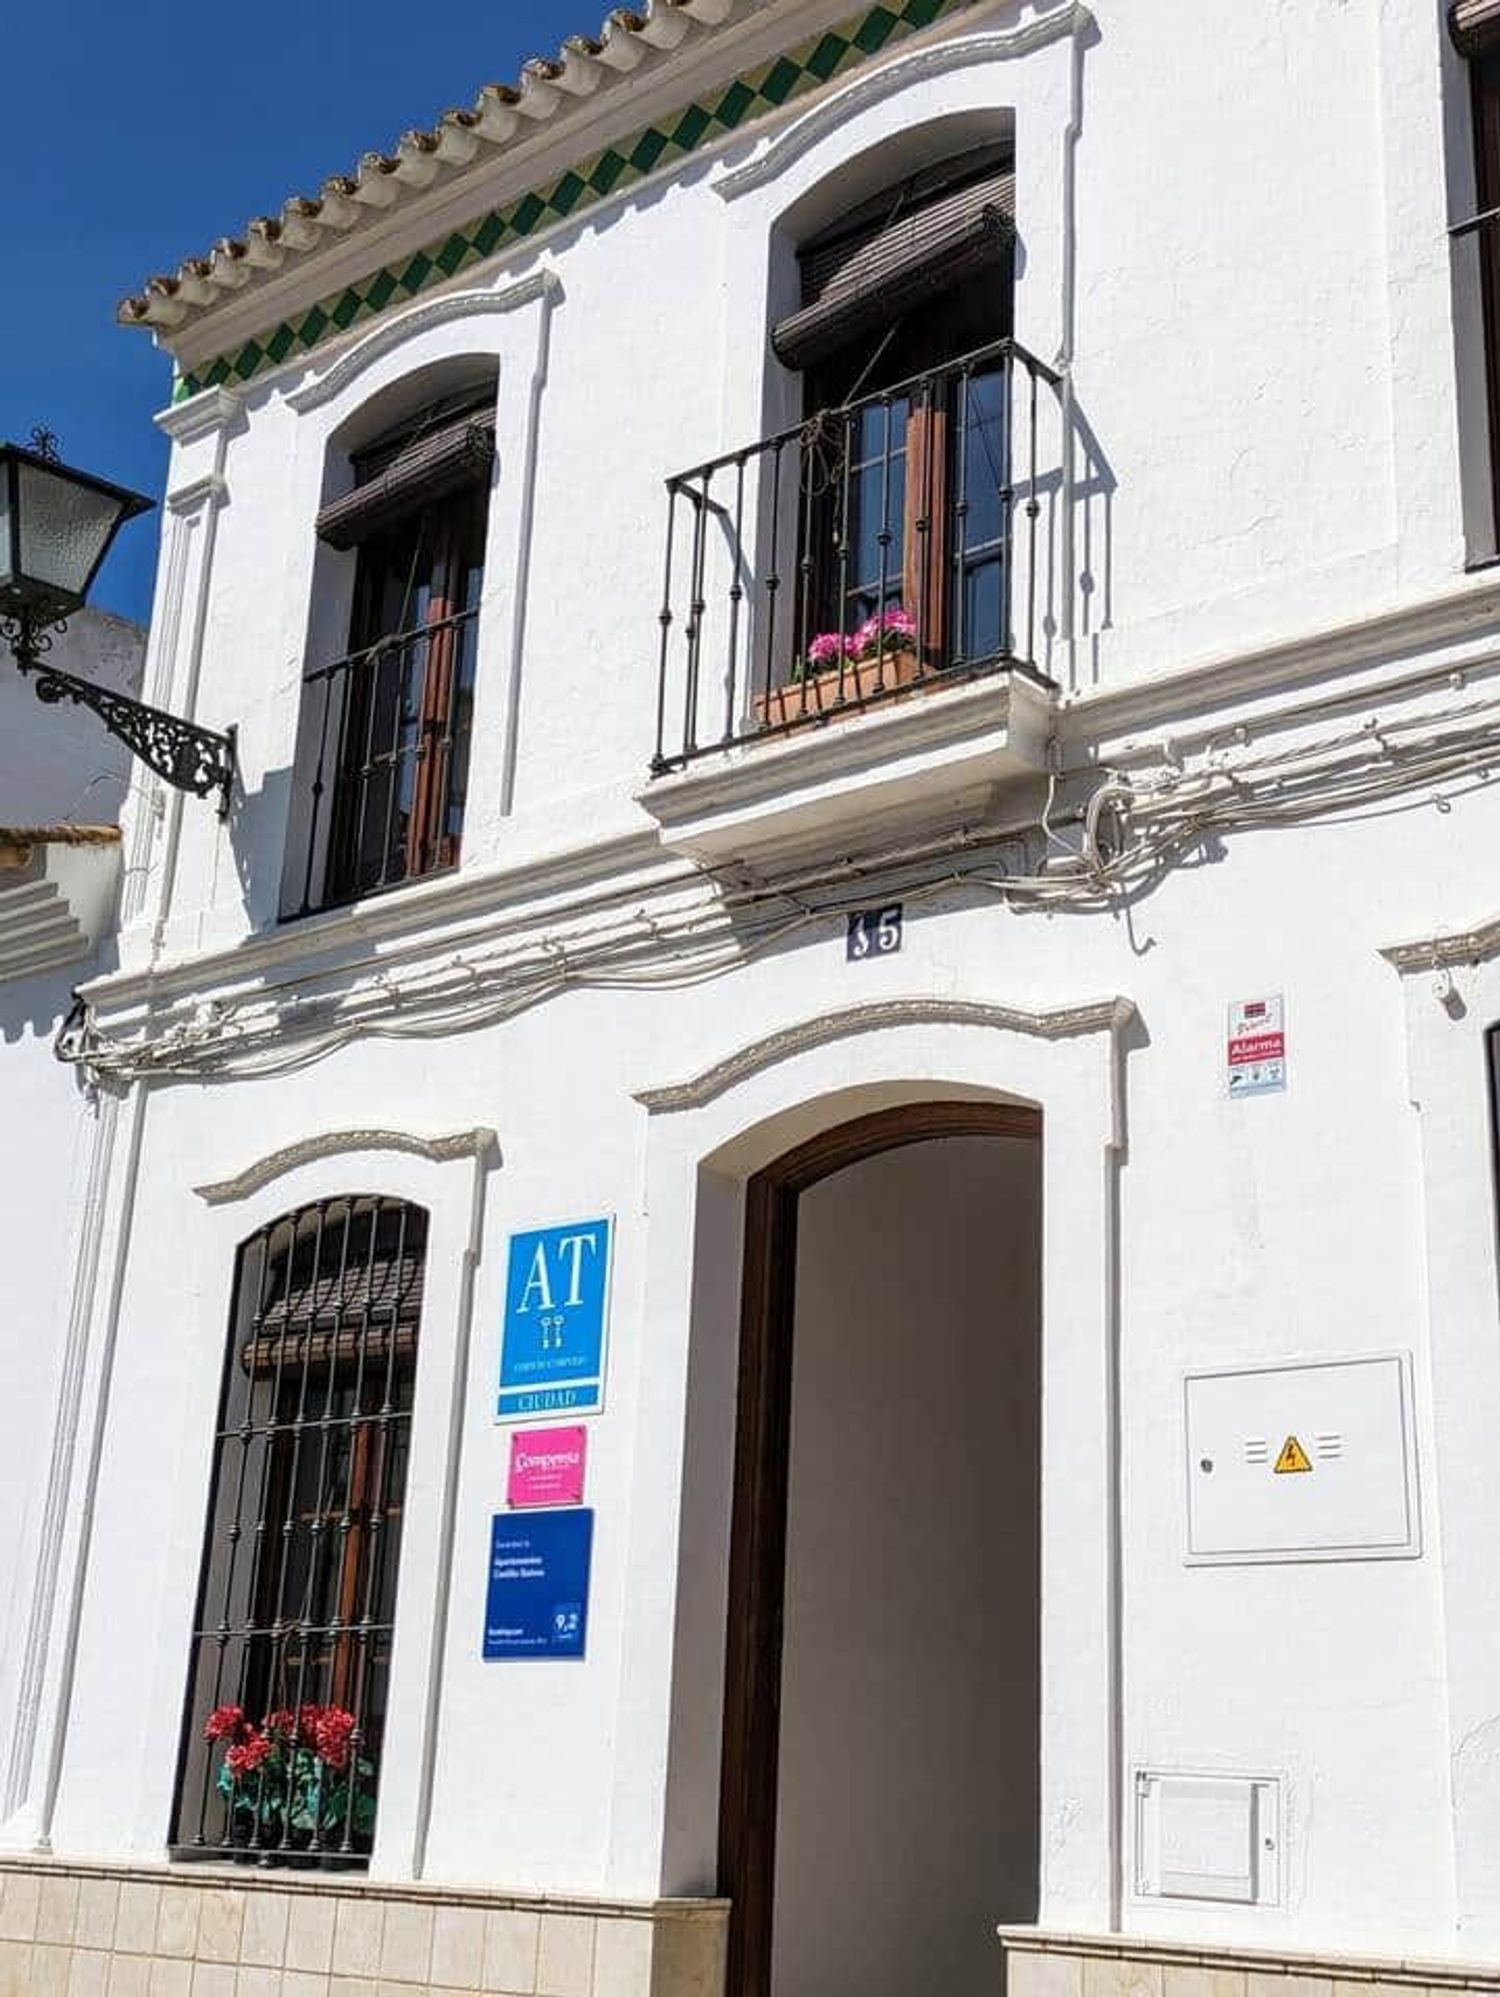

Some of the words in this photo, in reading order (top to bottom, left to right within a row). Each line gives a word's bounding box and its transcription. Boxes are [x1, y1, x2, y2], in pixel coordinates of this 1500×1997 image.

[1231, 1038, 1281, 1056] Alarma
[515, 1233, 597, 1314] AT
[518, 1390, 577, 1410] CIUDAD
